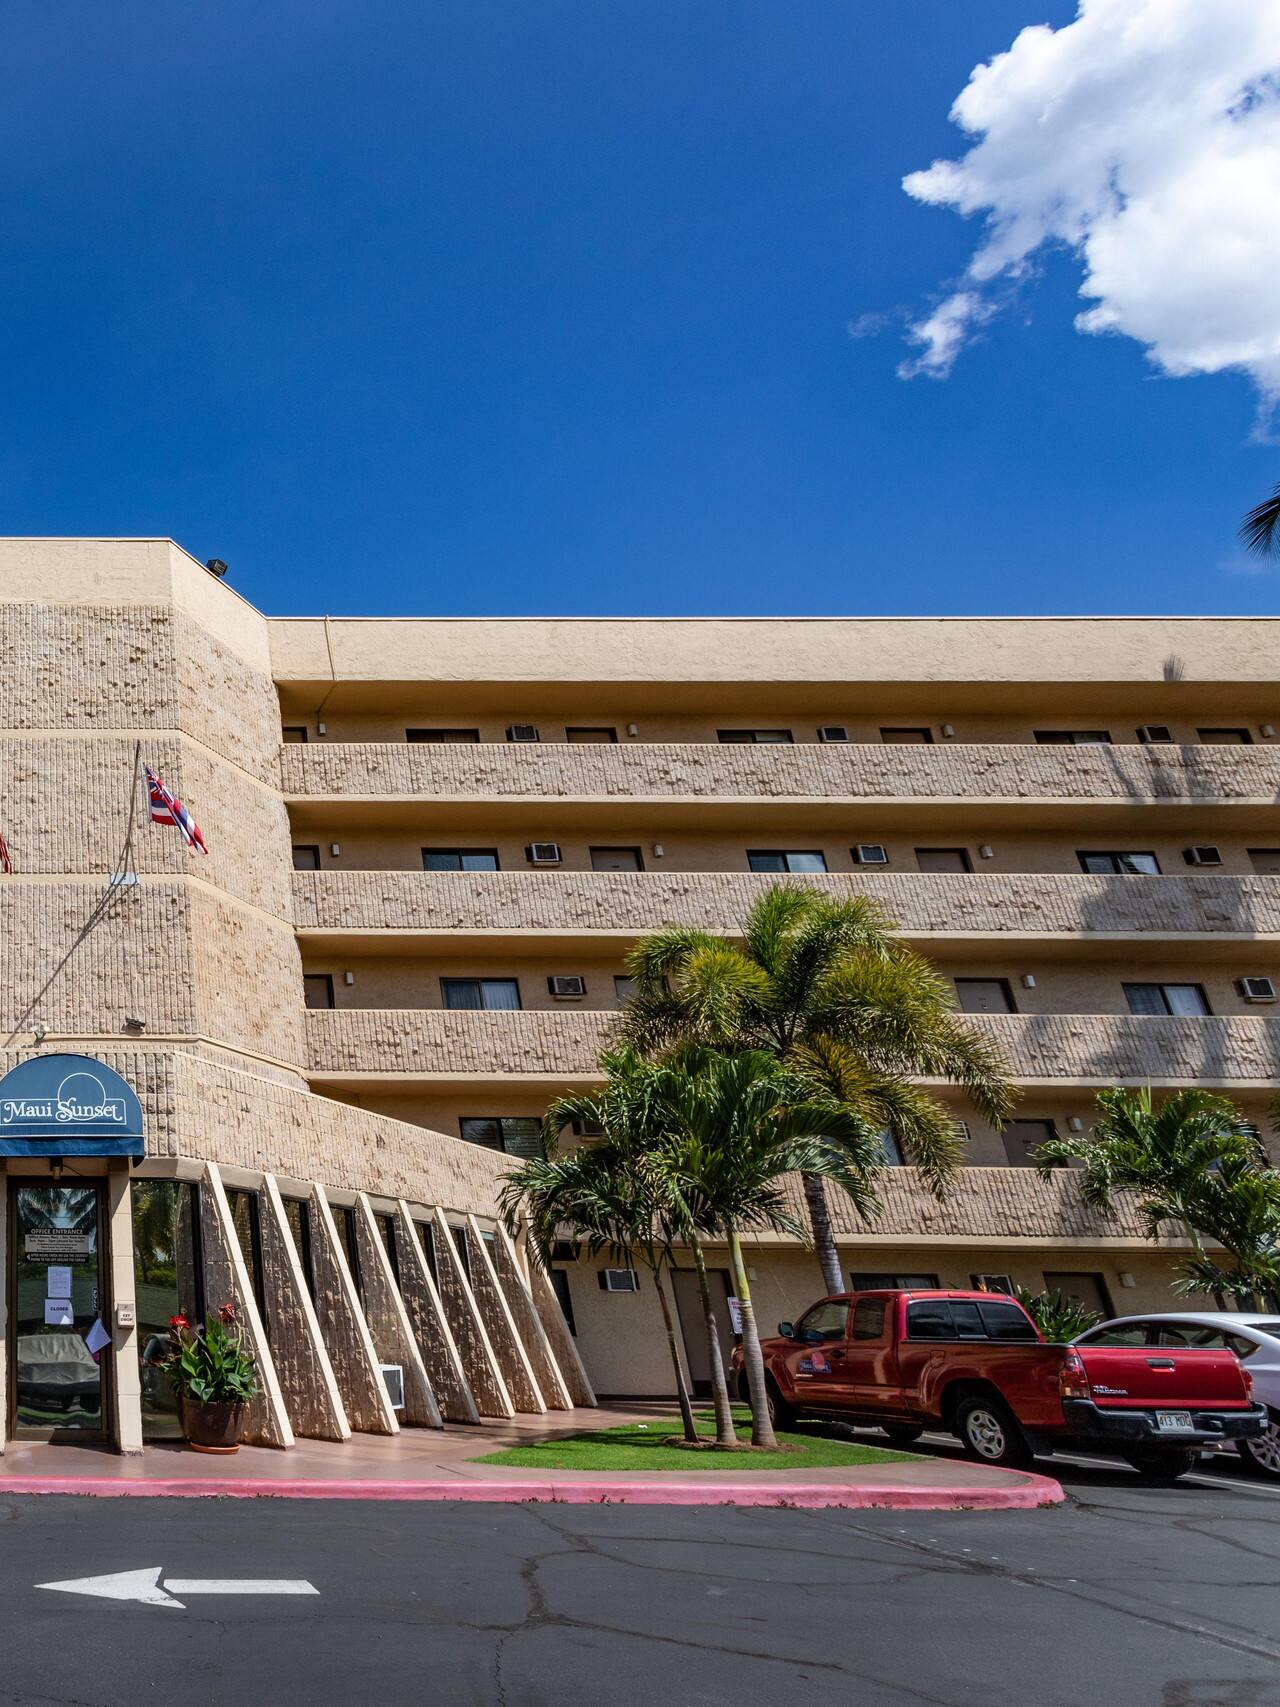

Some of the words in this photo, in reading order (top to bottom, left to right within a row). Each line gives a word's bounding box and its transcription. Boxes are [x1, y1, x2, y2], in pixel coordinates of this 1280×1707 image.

[3, 1101, 52, 1123] Maui
[55, 1097, 123, 1122] Sunset
[1160, 1415, 1173, 1426] 413
